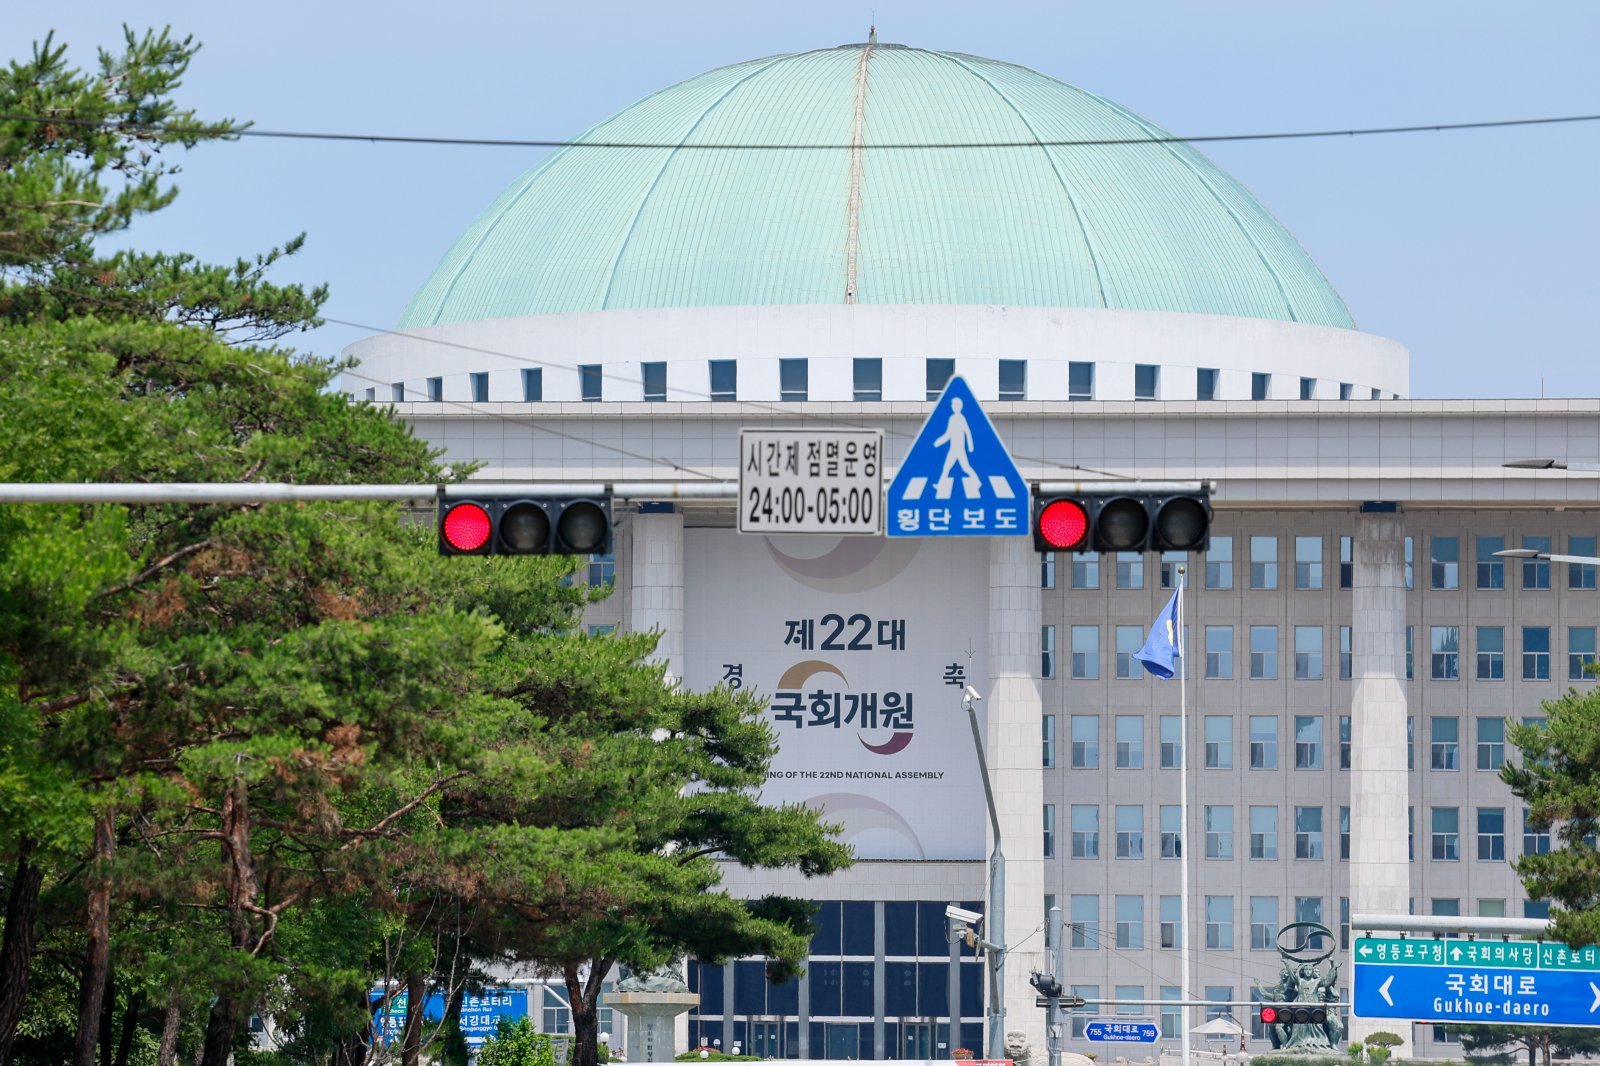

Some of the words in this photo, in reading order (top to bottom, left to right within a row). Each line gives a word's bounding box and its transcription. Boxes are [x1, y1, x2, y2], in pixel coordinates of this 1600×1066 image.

[747, 440, 800, 477] 시간제
[806, 440, 877, 478] 점멸운영
[749, 486, 873, 524] 24:00-05:00
[897, 508, 1018, 531] 횡단보도
[784, 613, 906, 651] 제22대
[722, 663, 743, 689] 경
[942, 662, 966, 689] 축
[770, 689, 914, 729] 국회개원
[767, 771, 784, 779] ING
[785, 771, 798, 779] OF
[800, 771, 818, 779] THE
[819, 771, 844, 779] 22ND
[845, 771, 893, 779] NATIONAL
[895, 771, 945, 779] ASSEMBLY
[1376, 943, 1443, 962] 영등포구청
[1466, 945, 1533, 965] 국회의사당
[1543, 948, 1600, 966] 신촌로터
[1445, 973, 1538, 997] 국회대로
[1433, 997, 1550, 1016] Gukhoe-daero
[1089, 1028, 1102, 1036] 755
[1104, 1024, 1139, 1033] 국회대로
[1142, 1029, 1155, 1037] 759
